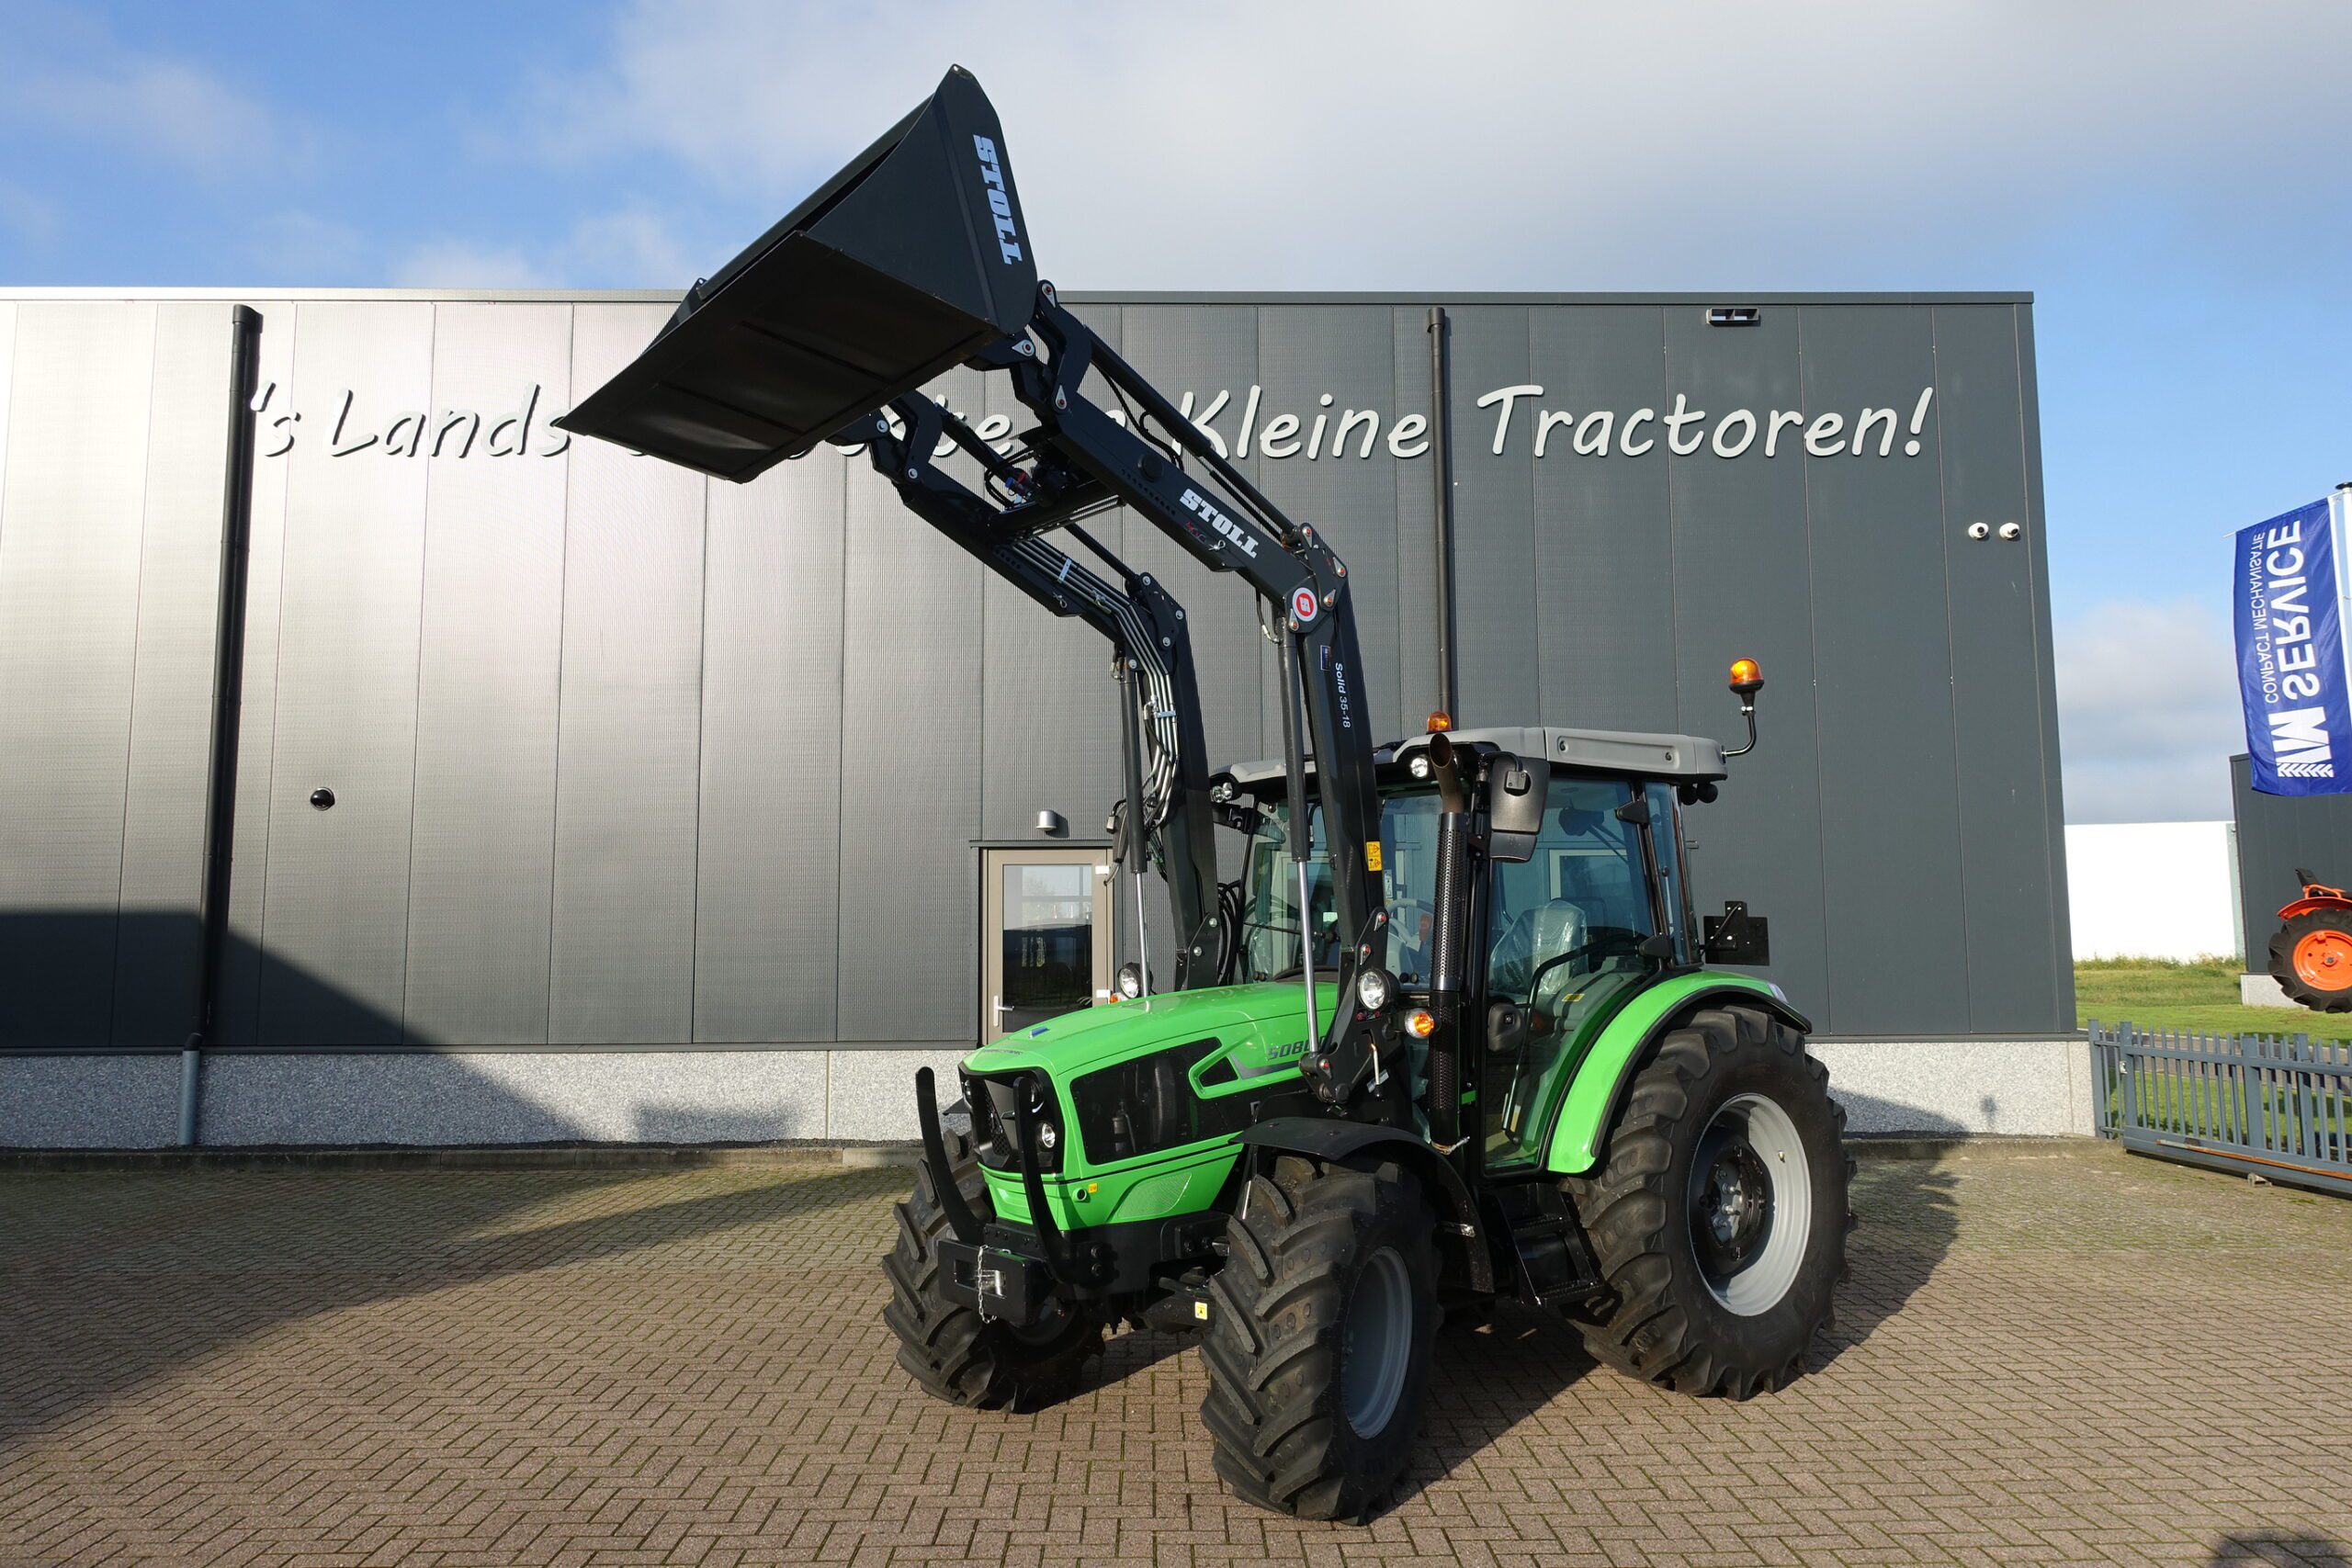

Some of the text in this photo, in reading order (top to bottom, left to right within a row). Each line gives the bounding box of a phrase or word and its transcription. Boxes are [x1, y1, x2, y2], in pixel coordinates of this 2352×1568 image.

[973, 134, 1023, 265] STOLL
[324, 381, 571, 458] Lands
[1171, 385, 1430, 460] Kleine
[1476, 385, 1933, 458] Tractoren!
[1179, 488, 1260, 558] STOLL
[1335, 662, 1351, 728] Solid 35-18
